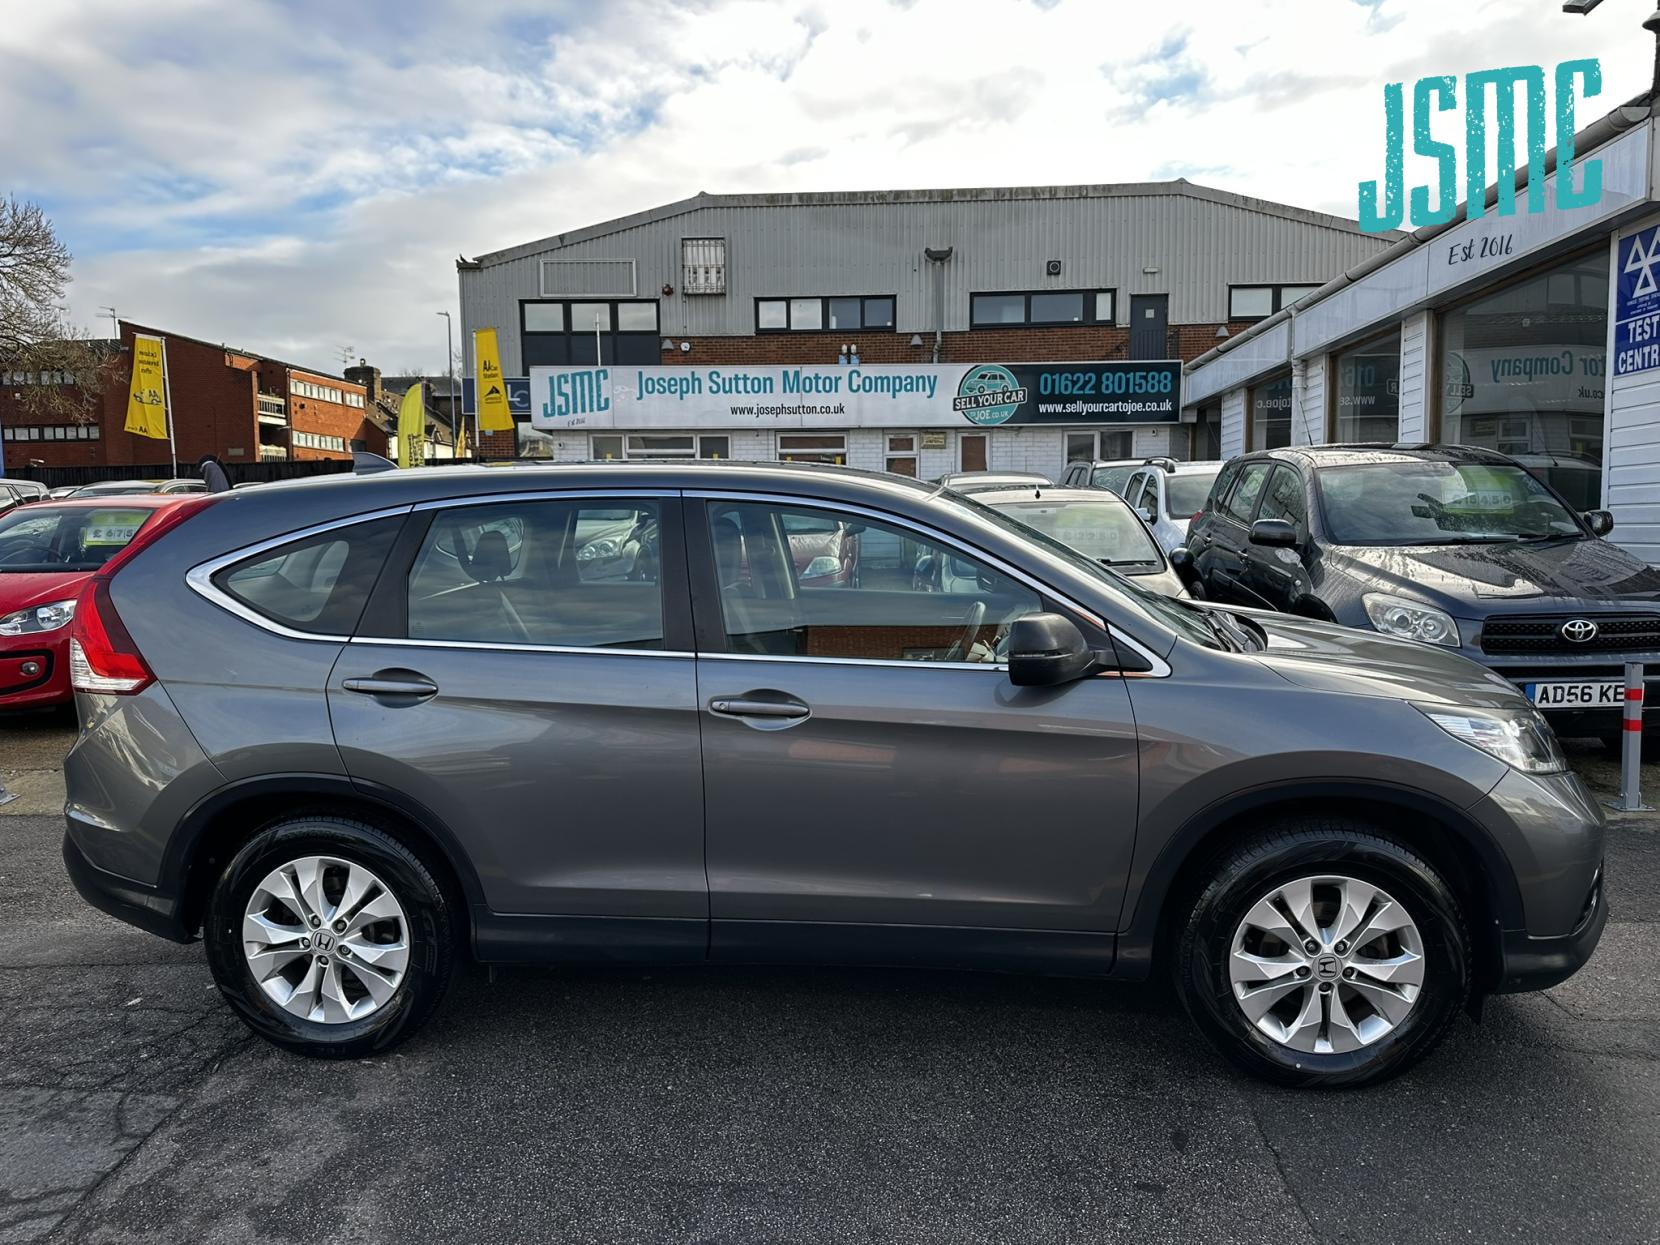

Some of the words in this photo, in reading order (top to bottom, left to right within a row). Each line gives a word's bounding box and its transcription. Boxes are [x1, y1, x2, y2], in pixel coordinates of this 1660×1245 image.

[1628, 315, 1660, 344] TEST
[543, 369, 610, 418] JSMC
[637, 371, 702, 400] Joseph
[708, 371, 772, 394] Sutton
[782, 370, 841, 394] Motor
[848, 369, 938, 399] Company
[1039, 372, 1096, 396] 01622
[1101, 371, 1172, 395] 801588
[730, 402, 845, 417] www.josephsutton.co.uk
[955, 397, 977, 409] SELL
[978, 393, 1004, 407] YOUR
[1004, 391, 1024, 403] CAR
[1038, 400, 1172, 415] www.sellyourcartojoe.co.uk
[1538, 684, 1593, 704] AD56
[1599, 684, 1625, 703] KE
